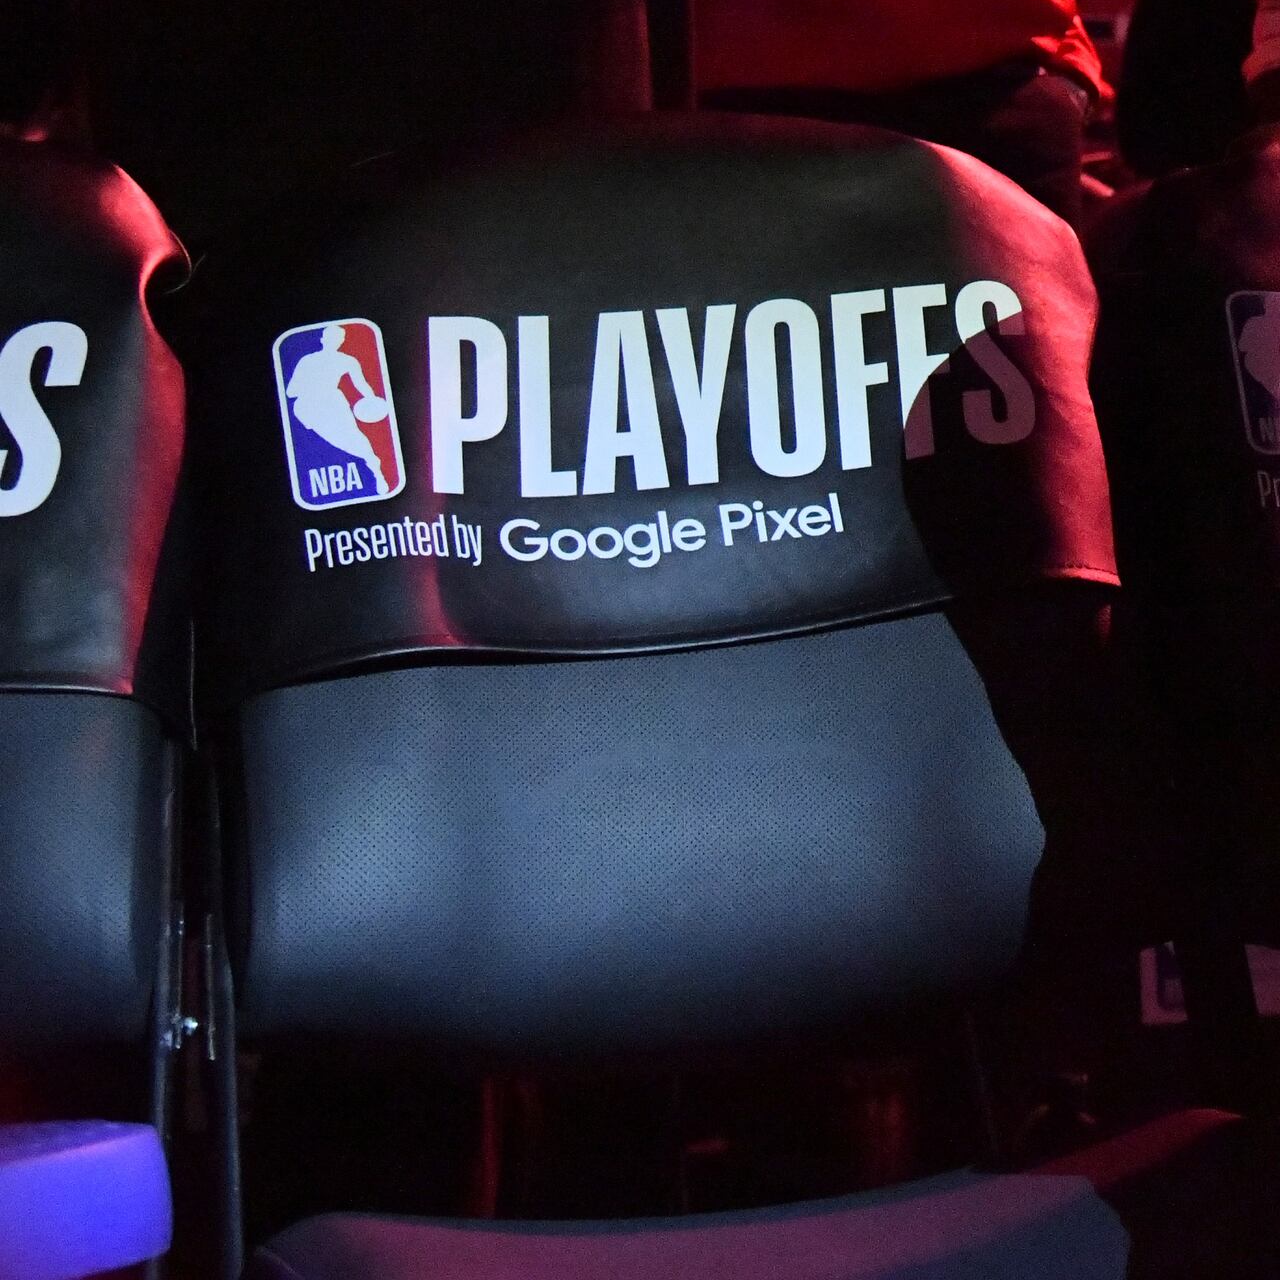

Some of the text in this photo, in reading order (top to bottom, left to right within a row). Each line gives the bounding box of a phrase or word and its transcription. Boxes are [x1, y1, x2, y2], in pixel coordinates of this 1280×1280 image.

[427, 279, 1037, 498] PLAYOFFS
[308, 462, 363, 498] NBA
[304, 492, 844, 572] Presented by Google Pixel
